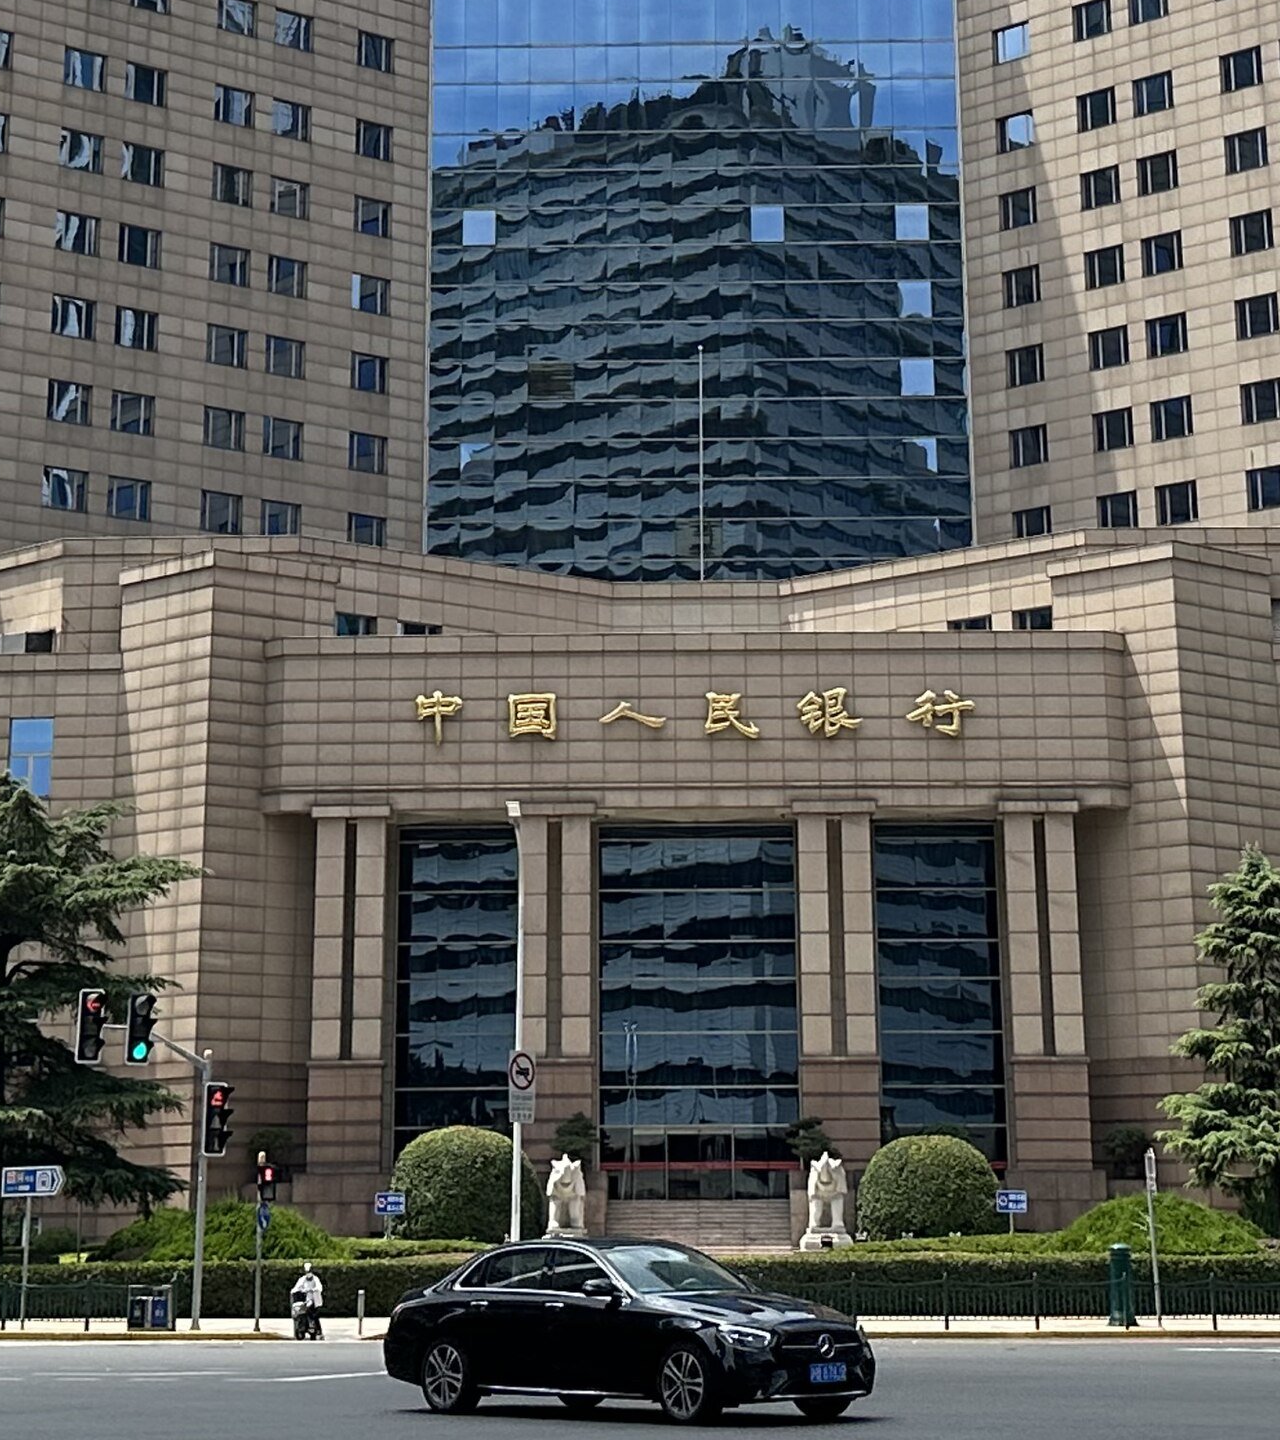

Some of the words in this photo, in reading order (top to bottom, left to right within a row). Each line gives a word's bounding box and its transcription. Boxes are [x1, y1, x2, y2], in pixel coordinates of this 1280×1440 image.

[414, 686, 976, 745] 中国人民银行
